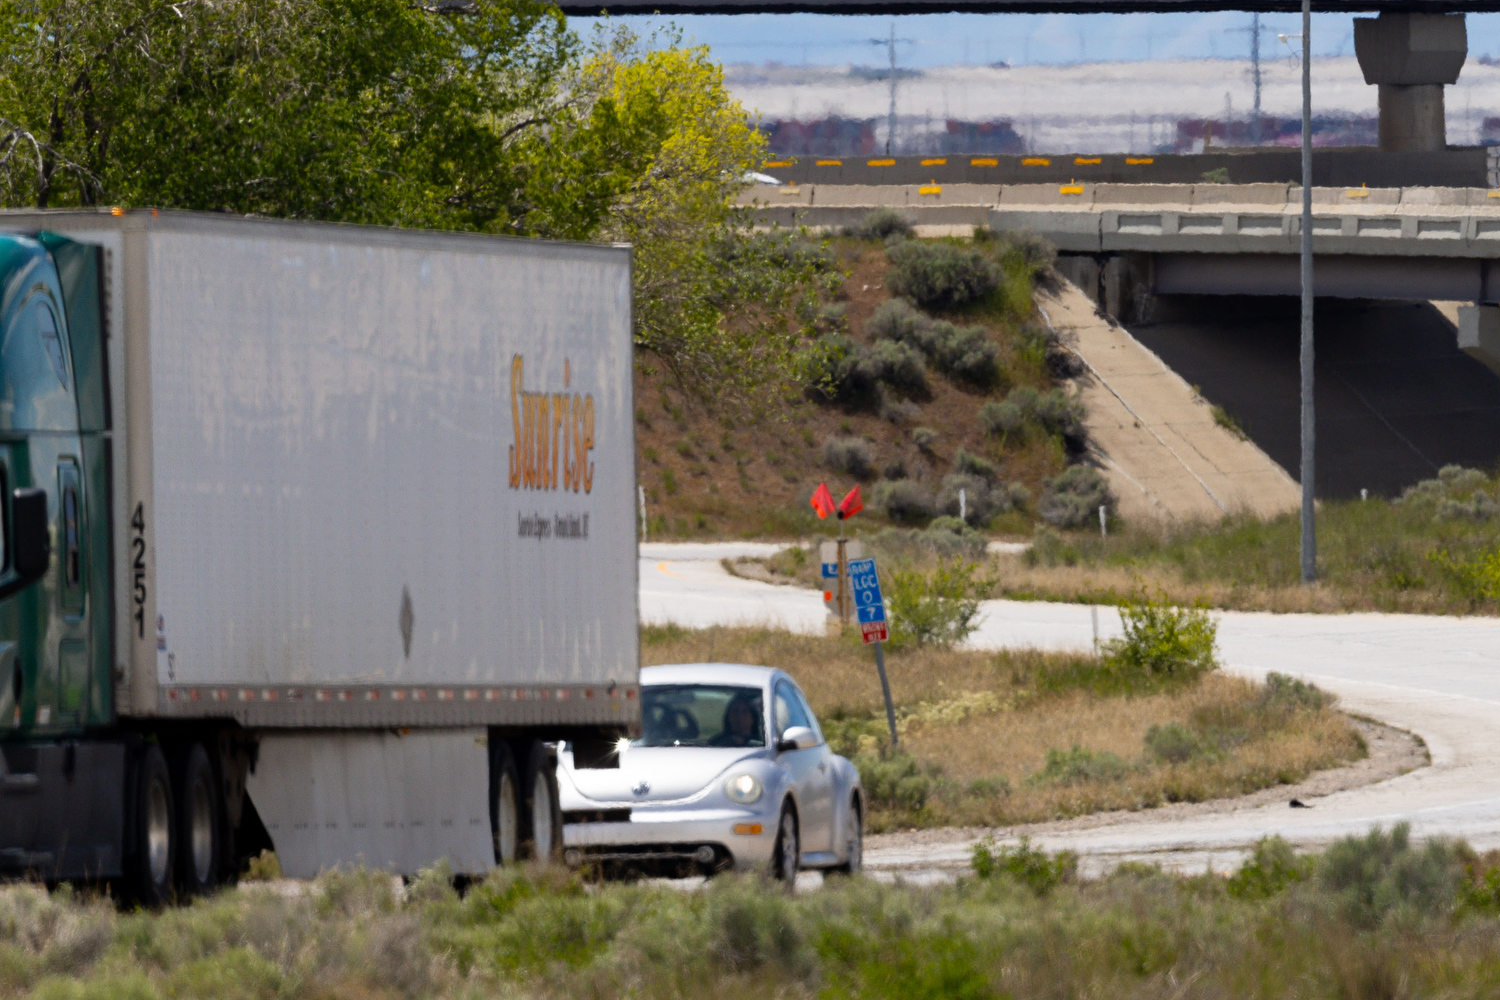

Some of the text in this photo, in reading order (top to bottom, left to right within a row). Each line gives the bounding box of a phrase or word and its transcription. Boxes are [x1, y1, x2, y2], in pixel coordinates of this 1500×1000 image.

[508, 353, 595, 494] Sunrise
[131, 500, 147, 640] 4251
[866, 607, 875, 619] 7
